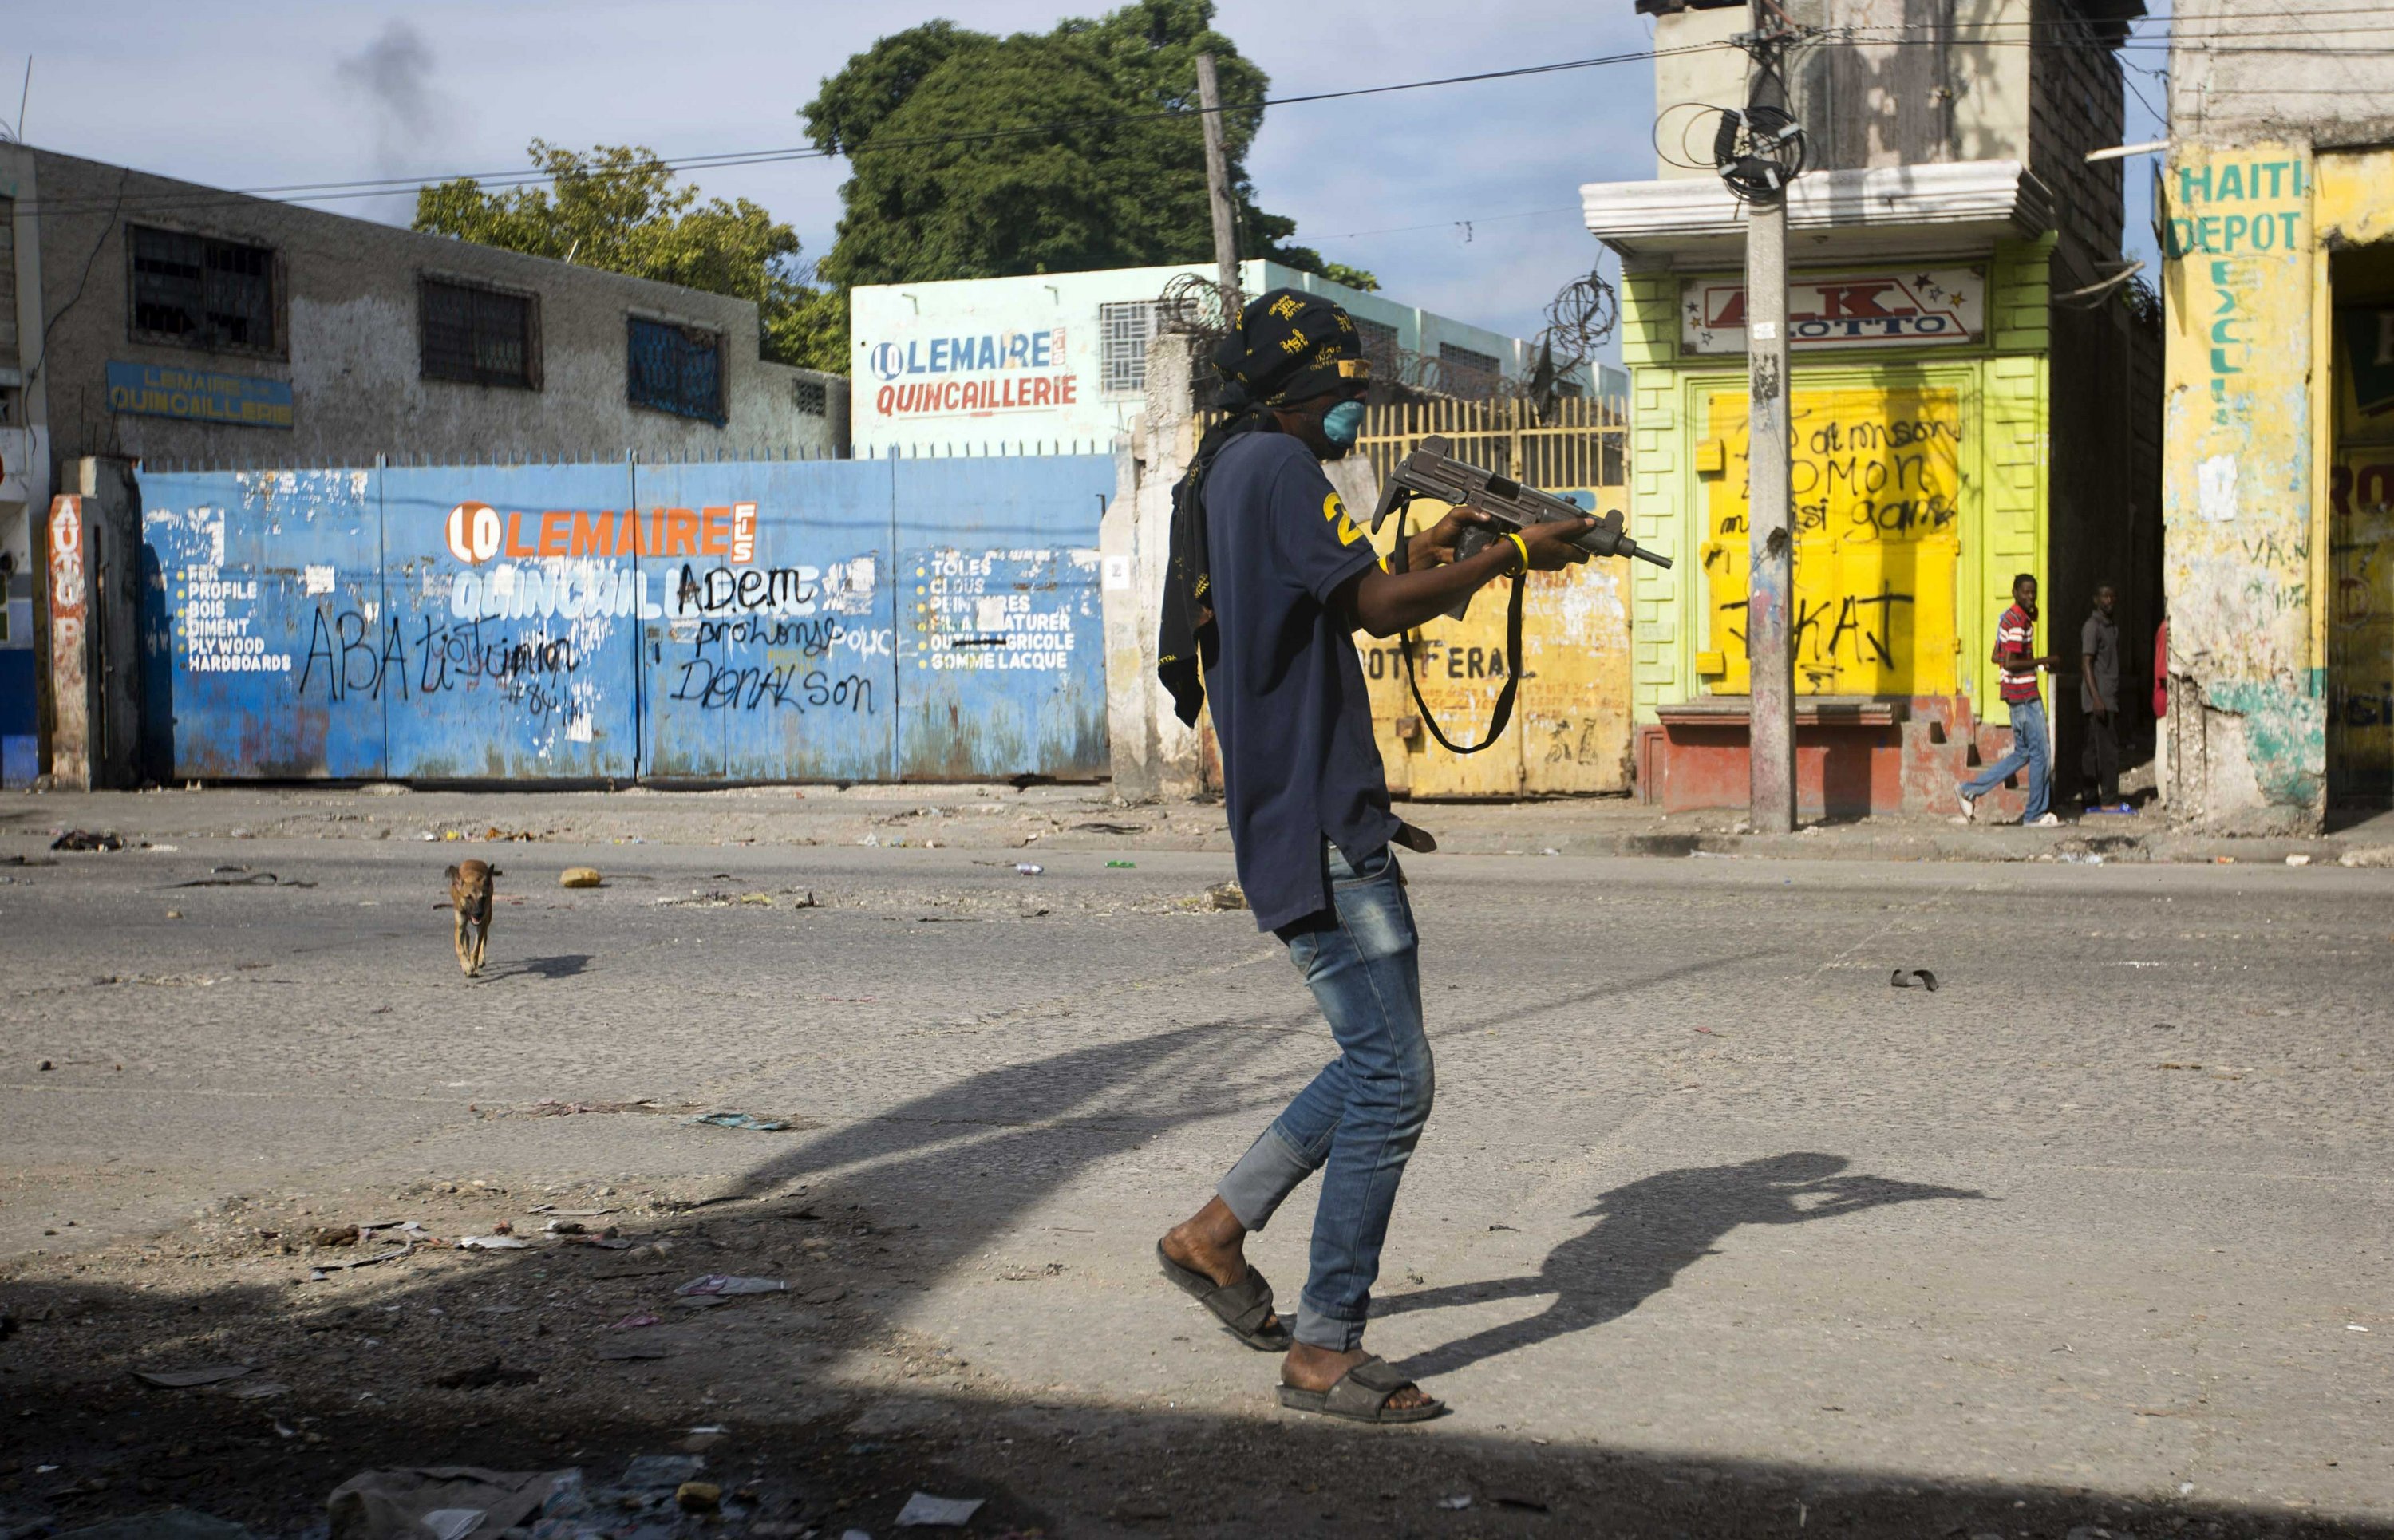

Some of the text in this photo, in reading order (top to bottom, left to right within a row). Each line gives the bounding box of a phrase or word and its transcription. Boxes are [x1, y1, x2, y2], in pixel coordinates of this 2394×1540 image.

[2180, 160, 2302, 204] HAITI
[2165, 211, 2301, 260] DEPOT
[1789, 315, 1947, 338] OTTO
[907, 331, 1051, 374] LEMAIRE
[144, 369, 241, 397] LEMAIRE
[876, 375, 1077, 417] QUINCAILLERIE
[110, 386, 294, 425] QUINCAILLERIE
[504, 506, 731, 558] LEMAIRE
[731, 503, 758, 563] FILS
[1323, 492, 1365, 547] 2
[51, 498, 82, 605] AUTO
[188, 581, 258, 599] PROFILE
[188, 600, 226, 618] BOIS
[931, 652, 1068, 672] GOMME LACQUE
[994, 633, 1076, 652] AGRICOLE
[189, 654, 292, 673] HARDBOARDS
